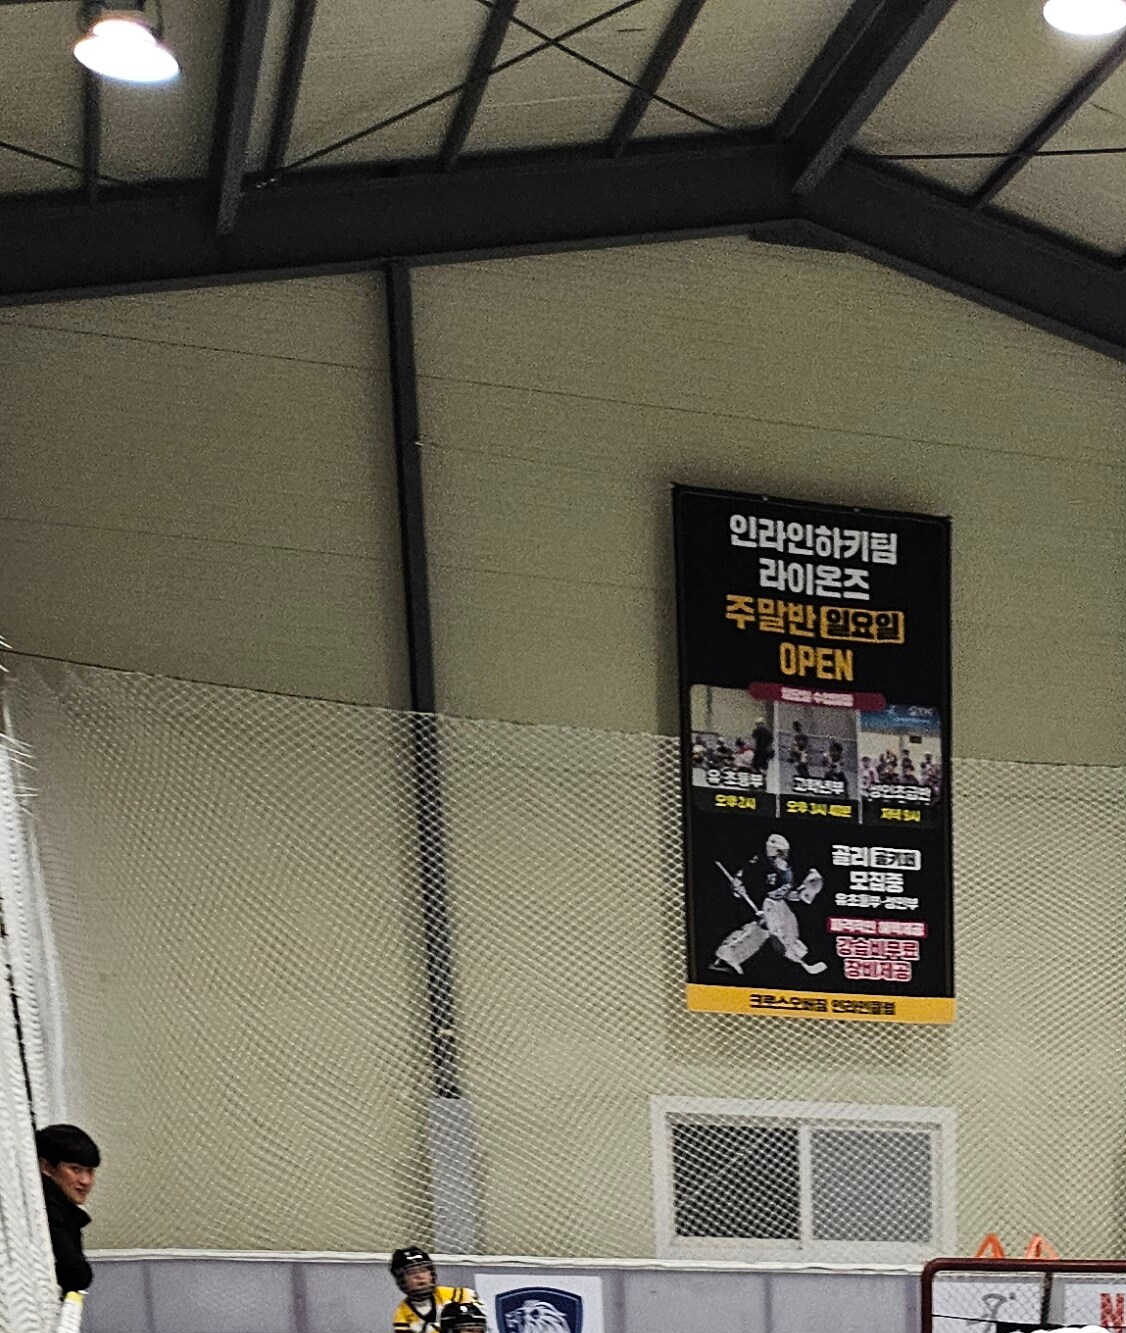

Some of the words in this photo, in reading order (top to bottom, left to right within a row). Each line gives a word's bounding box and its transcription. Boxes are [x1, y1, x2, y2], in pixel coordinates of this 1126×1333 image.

[729, 514, 898, 566] 인라인하키팀
[758, 557, 870, 601] 라이온즈
[725, 594, 816, 638] 주말반
[825, 608, 900, 640] 일요일
[779, 642, 854, 682] OPEN
[832, 845, 868, 867] 골리
[849, 871, 904, 893] 모집중
[836, 936, 921, 961] 강습비무료
[843, 958, 912, 982] 장비제공
